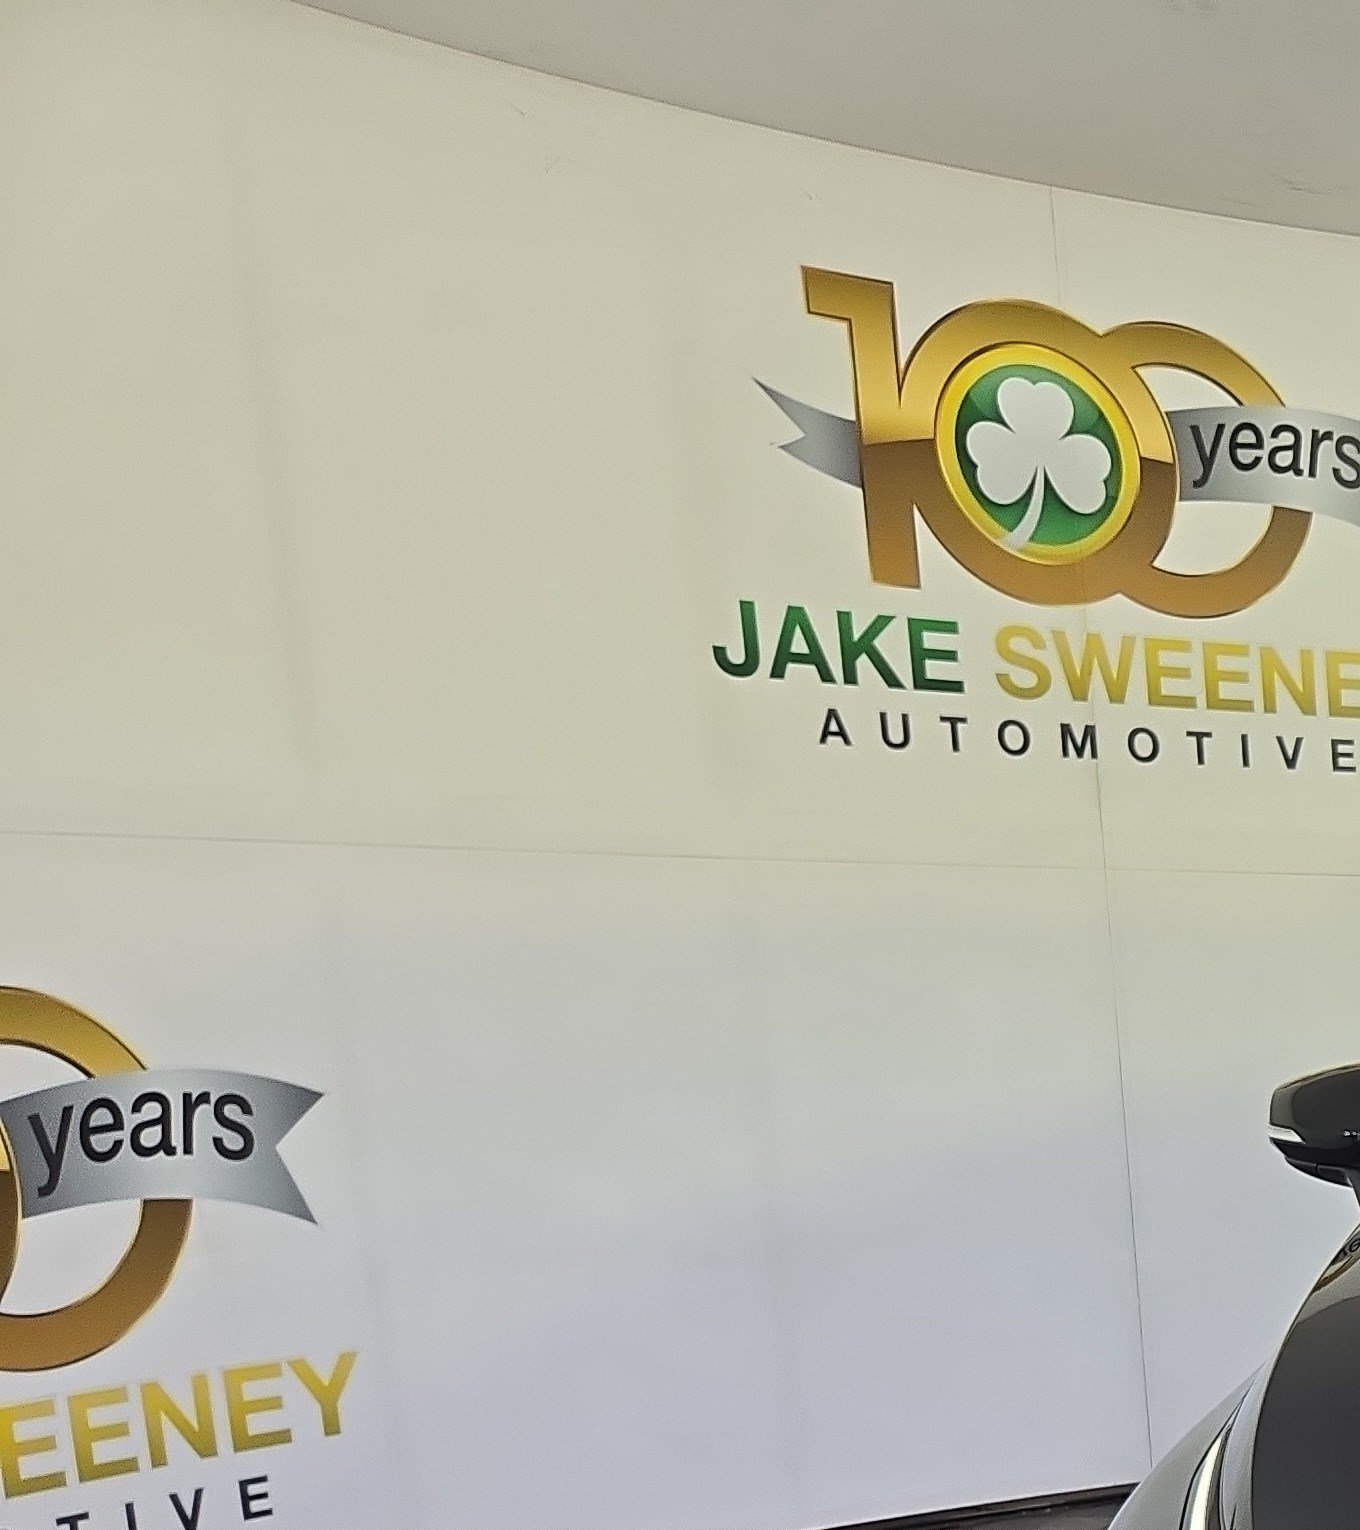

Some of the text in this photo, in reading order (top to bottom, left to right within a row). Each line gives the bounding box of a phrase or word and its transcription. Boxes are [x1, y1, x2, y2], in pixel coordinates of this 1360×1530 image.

[711, 600, 966, 695] JAKE
[818, 707, 1358, 773] AUTOMOTIVE
[28, 1089, 256, 1198] years
